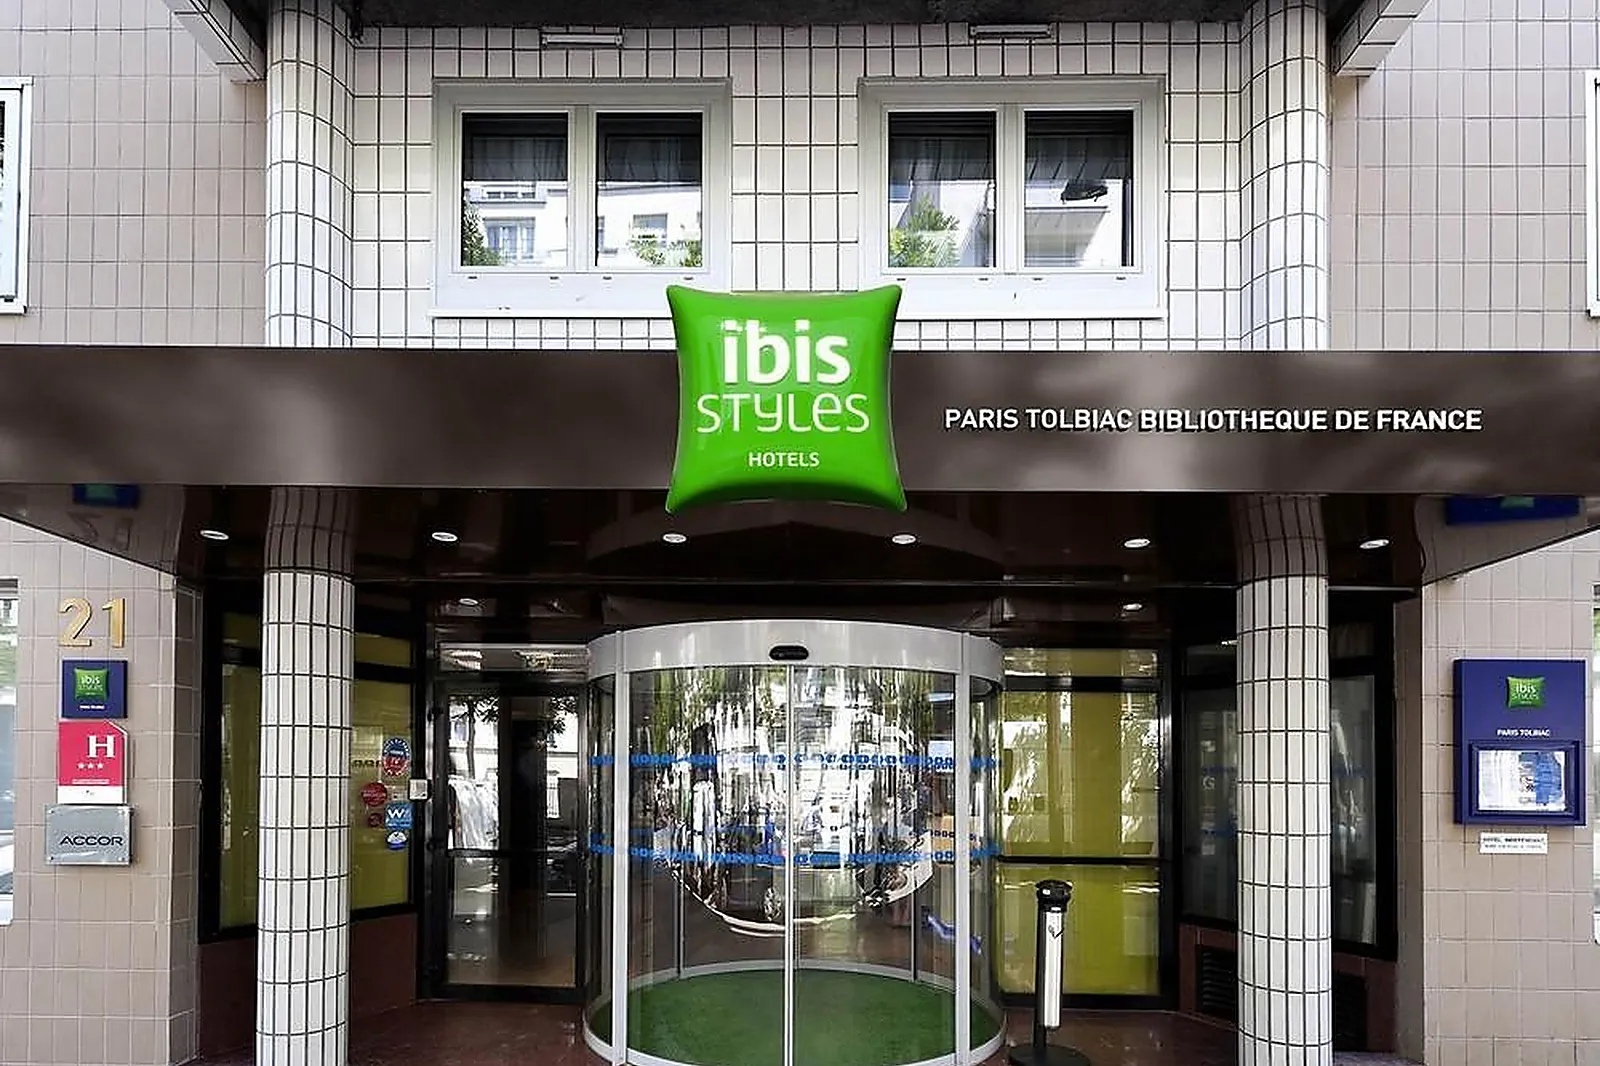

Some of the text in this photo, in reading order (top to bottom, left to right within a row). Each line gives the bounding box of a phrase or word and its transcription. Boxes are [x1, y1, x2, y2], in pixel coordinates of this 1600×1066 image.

[723, 319, 851, 384] ibis
[944, 408, 1482, 431] PARIS TOLBIAC BIBLIOTHEQUE DE FRANCE
[748, 452, 820, 468] HOTELS
[58, 598, 126, 648] 21
[1515, 682, 1537, 693] ibis
[87, 735, 116, 758] H
[60, 836, 124, 846] ACCOR
